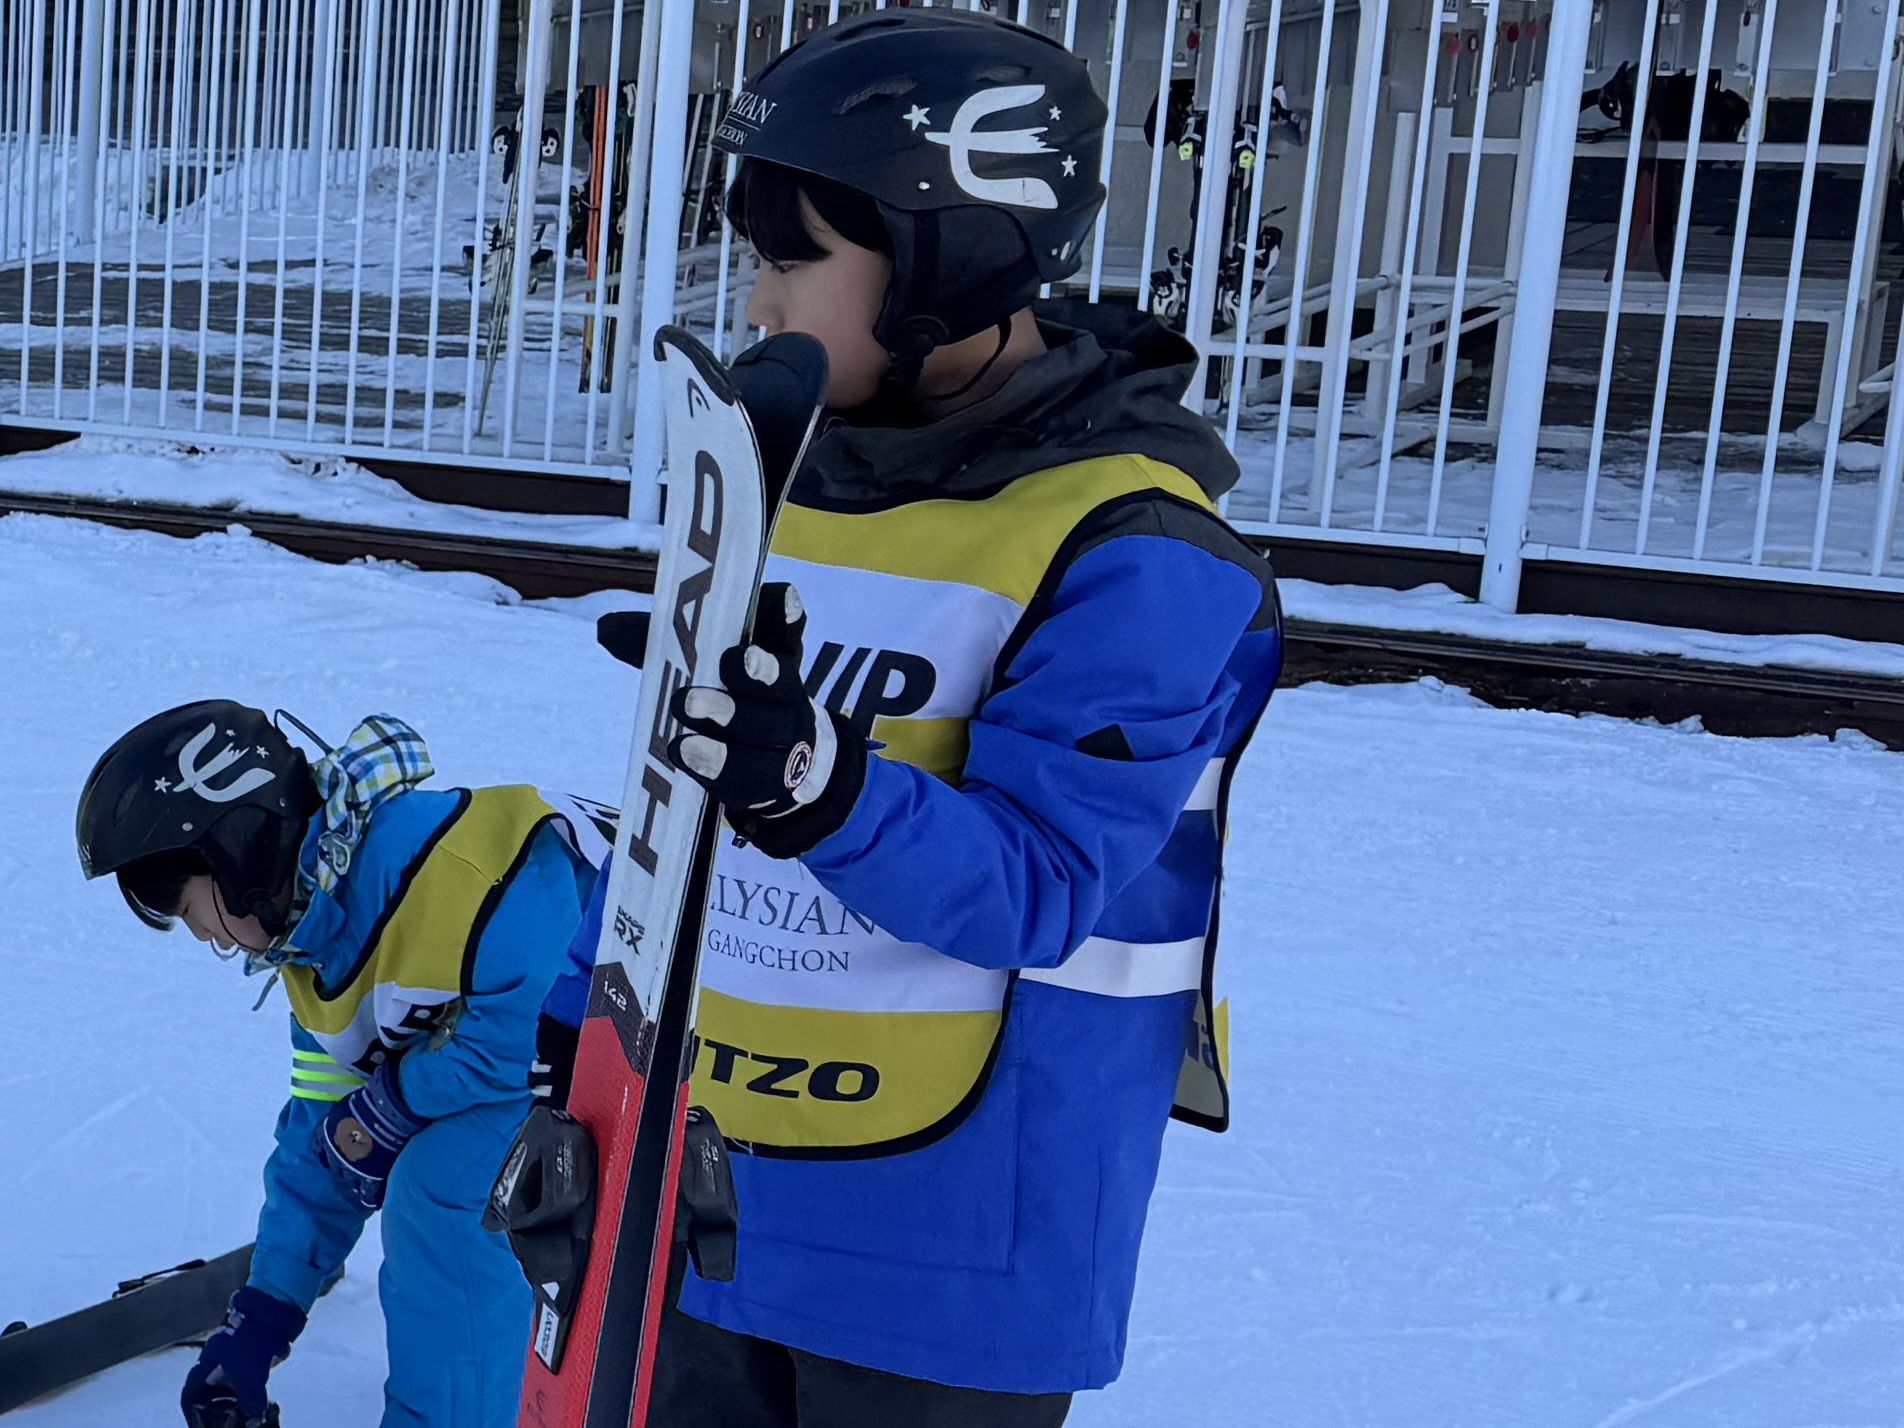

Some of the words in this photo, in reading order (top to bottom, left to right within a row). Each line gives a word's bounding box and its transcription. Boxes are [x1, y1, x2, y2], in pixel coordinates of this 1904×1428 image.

[629, 450, 724, 877] HEAD
[710, 874, 878, 936] LYSIAN
[708, 929, 850, 973] GANGCHON
[604, 980, 627, 1011] 142
